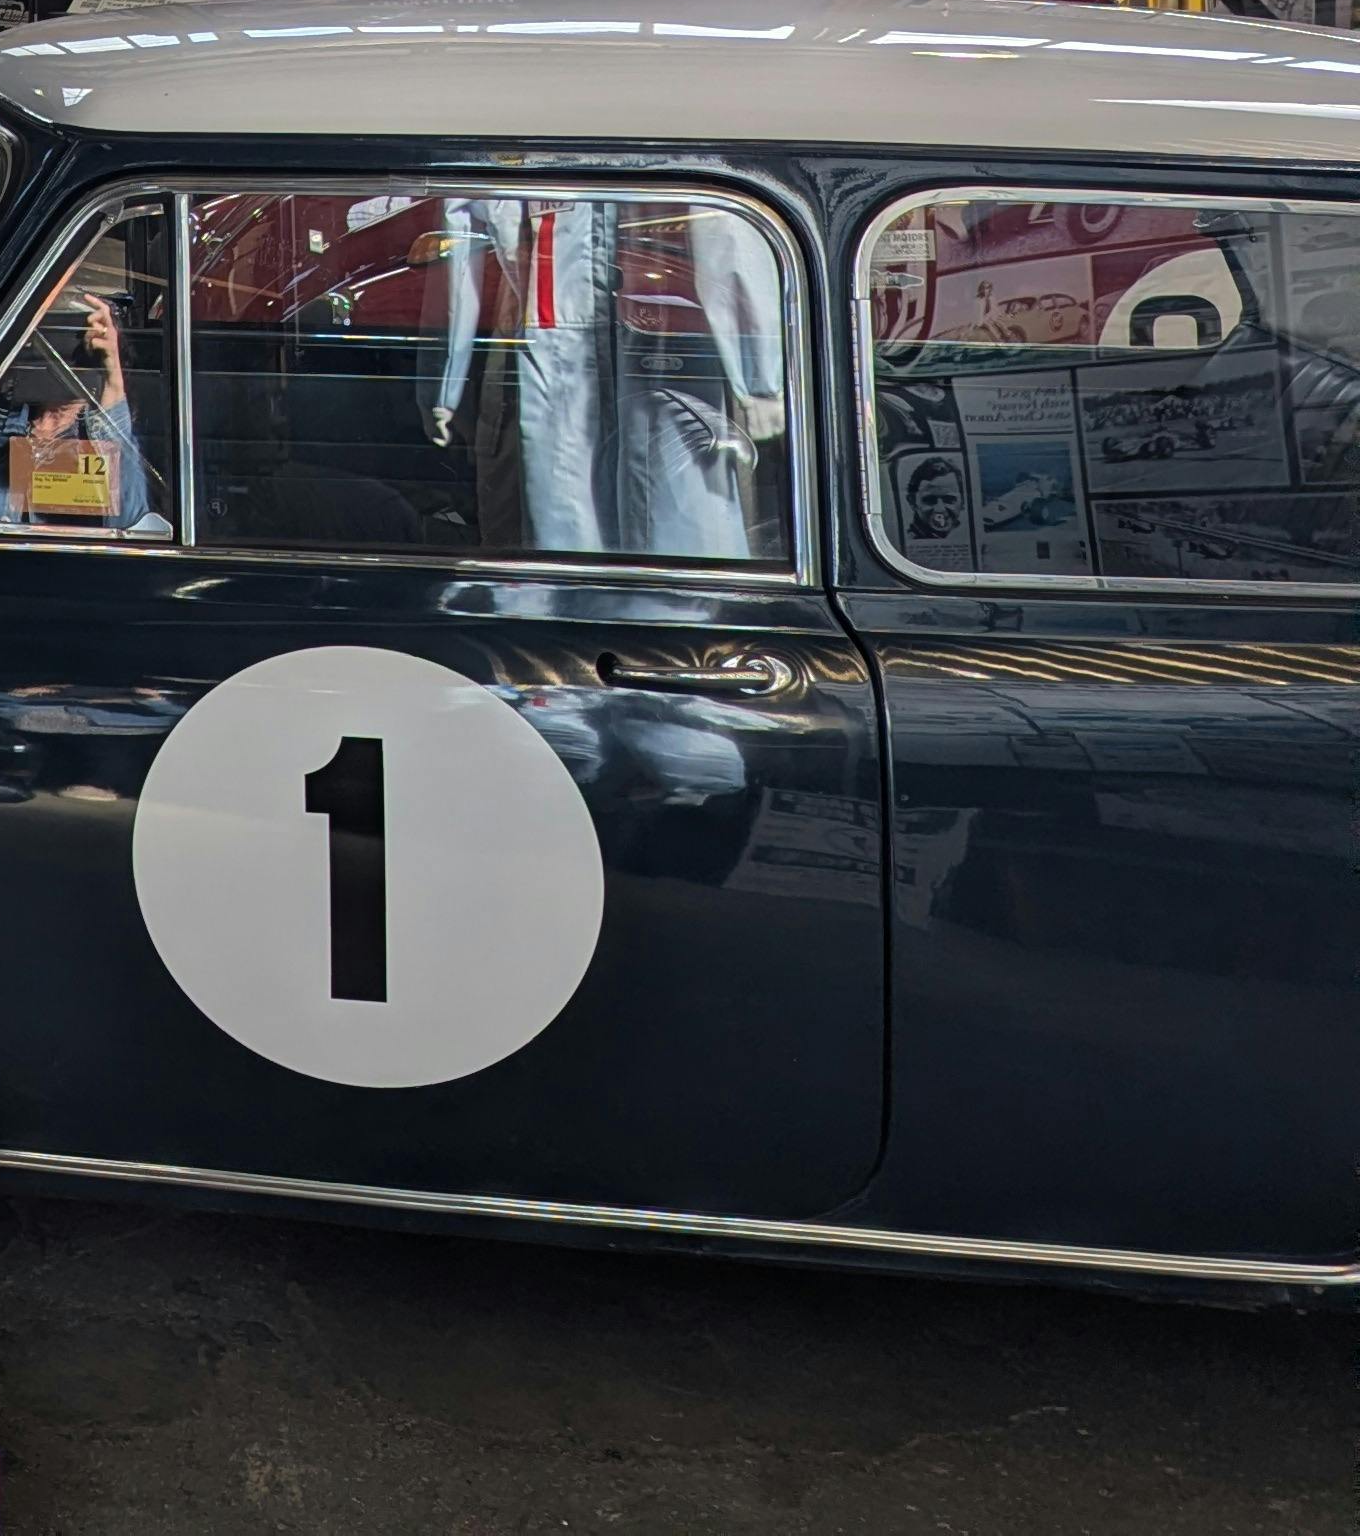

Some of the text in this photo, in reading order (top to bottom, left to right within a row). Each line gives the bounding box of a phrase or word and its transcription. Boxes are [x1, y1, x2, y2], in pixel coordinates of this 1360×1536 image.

[893, 233, 929, 242] MOTORS
[82, 456, 106, 475] 12
[305, 736, 387, 1003] 1
